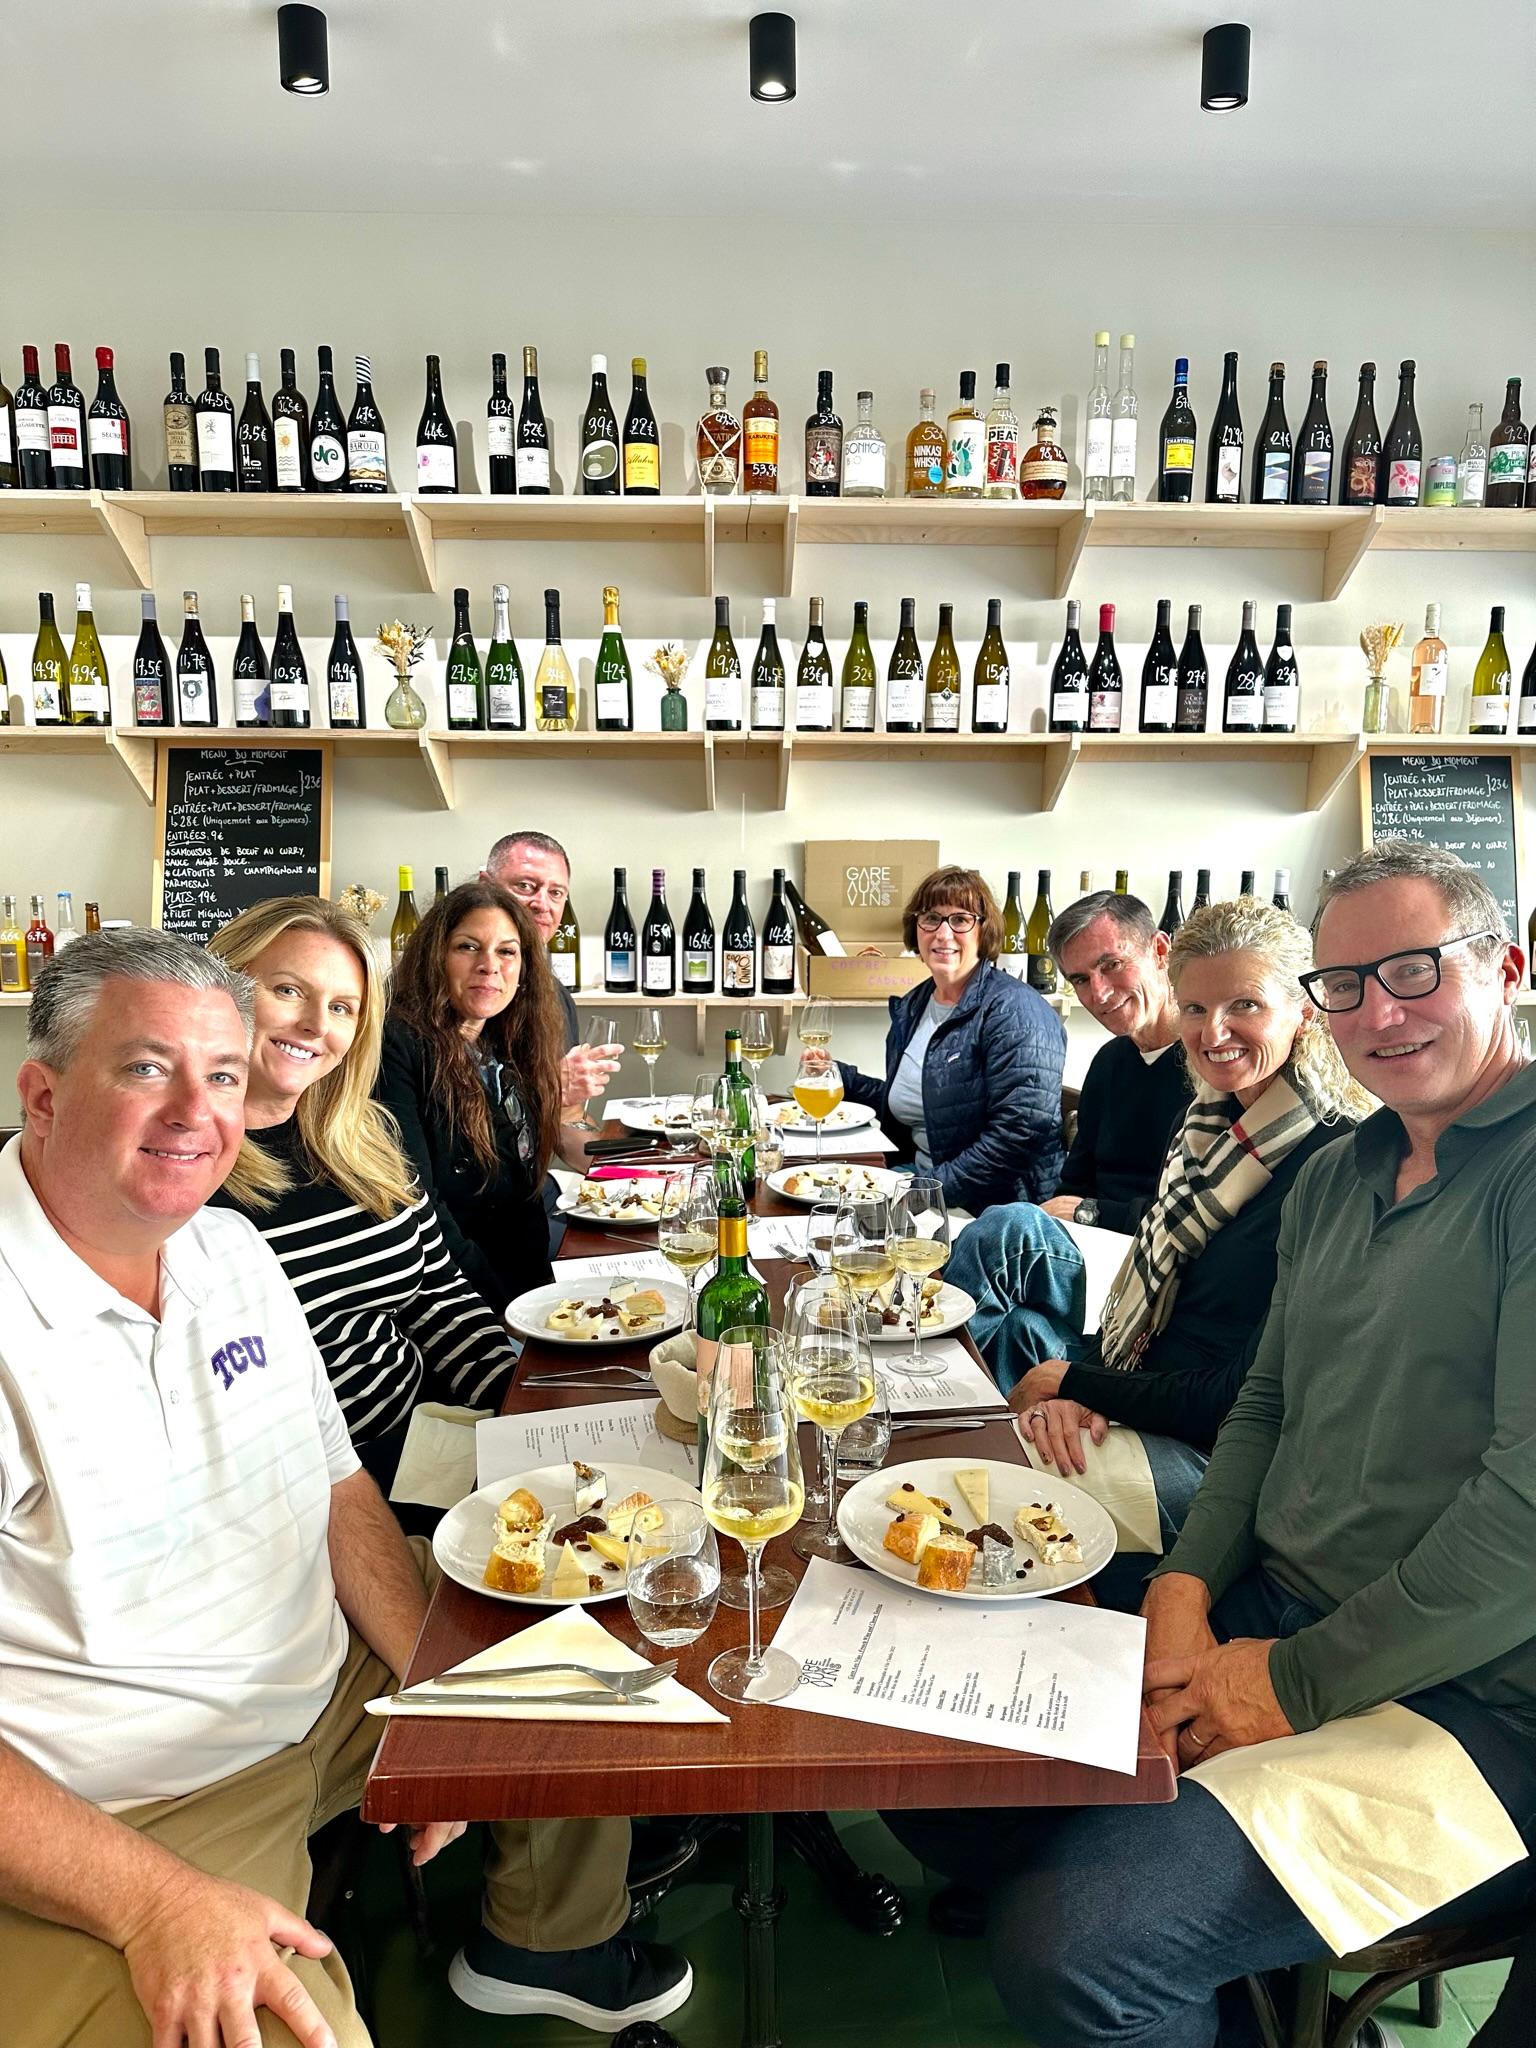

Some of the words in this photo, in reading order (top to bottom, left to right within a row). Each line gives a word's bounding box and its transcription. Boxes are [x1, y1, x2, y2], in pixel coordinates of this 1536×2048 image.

[16, 387, 44, 408] 8,9€
[49, 387, 80, 407] 15,5€
[201, 391, 232, 411] 14,5€
[91, 400, 126, 418] 24,5€
[491, 400, 512, 416] 43€
[1094, 396, 1111, 415] 57€
[239, 424, 267, 441] 13,5€
[424, 420, 448, 440] 44€
[523, 421, 545, 437] 52€
[588, 416, 613, 438] 39€
[631, 418, 655, 437] 22€
[988, 430, 1018, 442] PEAT
[1270, 431, 1291, 448] 21€
[1310, 431, 1331, 449] 17€
[914, 445, 942, 457] NINKASI
[1361, 441, 1380, 455] 12€
[914, 457, 942, 468] WHISKY
[136, 658, 163, 677] 17,5€
[180, 653, 206, 669] 11,7€
[235, 656, 257, 673] 16€
[275, 667, 302, 680] 10,5€
[451, 664, 480, 684] 27,5€
[491, 664, 518, 682] 29,9€
[603, 661, 626, 680] 42€
[803, 667, 823, 684] 23€
[851, 665, 873, 682] 32€
[937, 668, 959, 685] 27€
[1187, 671, 1205, 684] 27€
[201, 750, 227, 759] MENU
[235, 750, 248, 759] DU
[251, 750, 289, 759] MOMENT
[1402, 756, 1425, 766] MENU
[1444, 757, 1479, 765] MOMENT
[188, 769, 224, 782] ENTRÉE
[235, 769, 257, 779] PLAT
[304, 775, 322, 789] 23€
[1388, 773, 1419, 785] ENTRÉE
[1427, 774, 1446, 784] PLAT
[1491, 777, 1508, 791] 23€
[180, 816, 200, 827] 28€
[1382, 813, 1401, 825] 28€
[211, 830, 224, 840] 9€
[1411, 829, 1425, 839] 9€
[220, 847, 230, 855] DE
[263, 847, 274, 855] AU
[165, 858, 189, 866] SAUCE
[1487, 861, 1496, 869] AU
[172, 868, 216, 877] CLAFOUTIS
[224, 868, 235, 876] DE
[846, 866, 891, 881] GARE
[198, 890, 217, 903] 19€
[847, 892, 891, 907] VINS
[163, 921, 197, 930] PRUNEAUX
[610, 932, 635, 947] 13,9€
[1004, 934, 1023, 951] 13€
[211, 1335, 267, 1391] TCU
[798, 1658, 819, 1685] GARE
